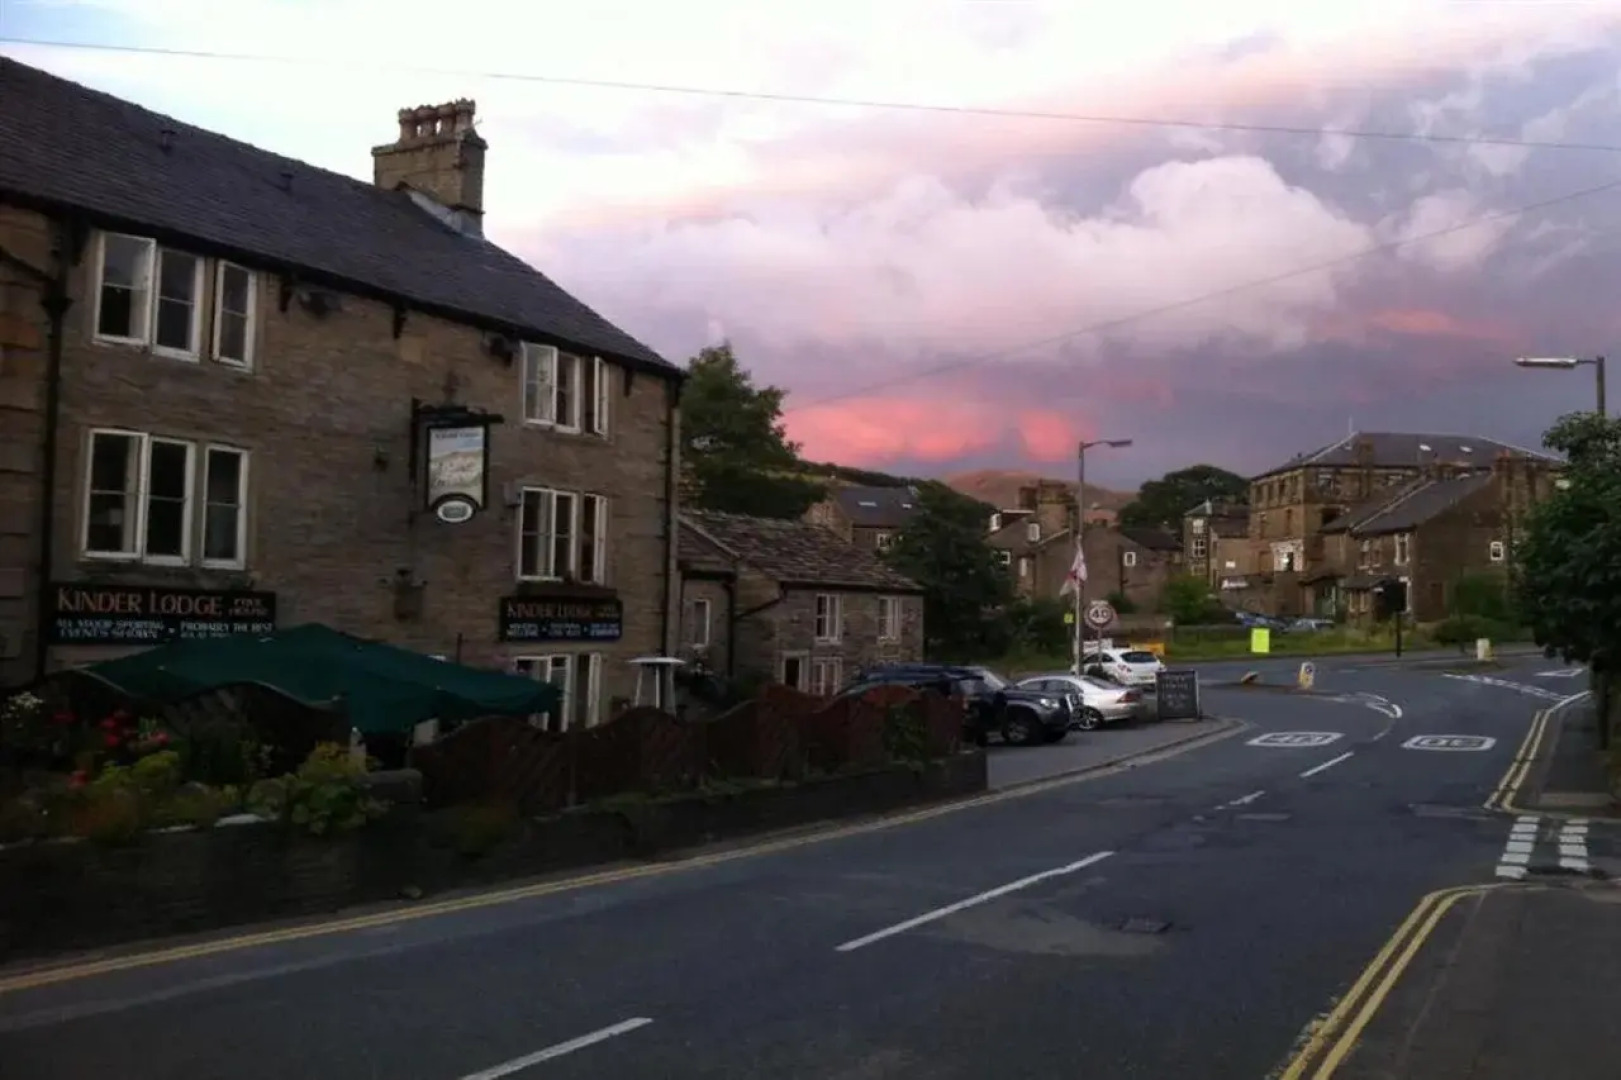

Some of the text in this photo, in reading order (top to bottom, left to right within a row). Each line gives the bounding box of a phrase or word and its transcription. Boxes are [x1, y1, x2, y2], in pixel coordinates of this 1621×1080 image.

[57, 586, 224, 616] KINDER LODGE
[1092, 609, 1110, 619] 40
